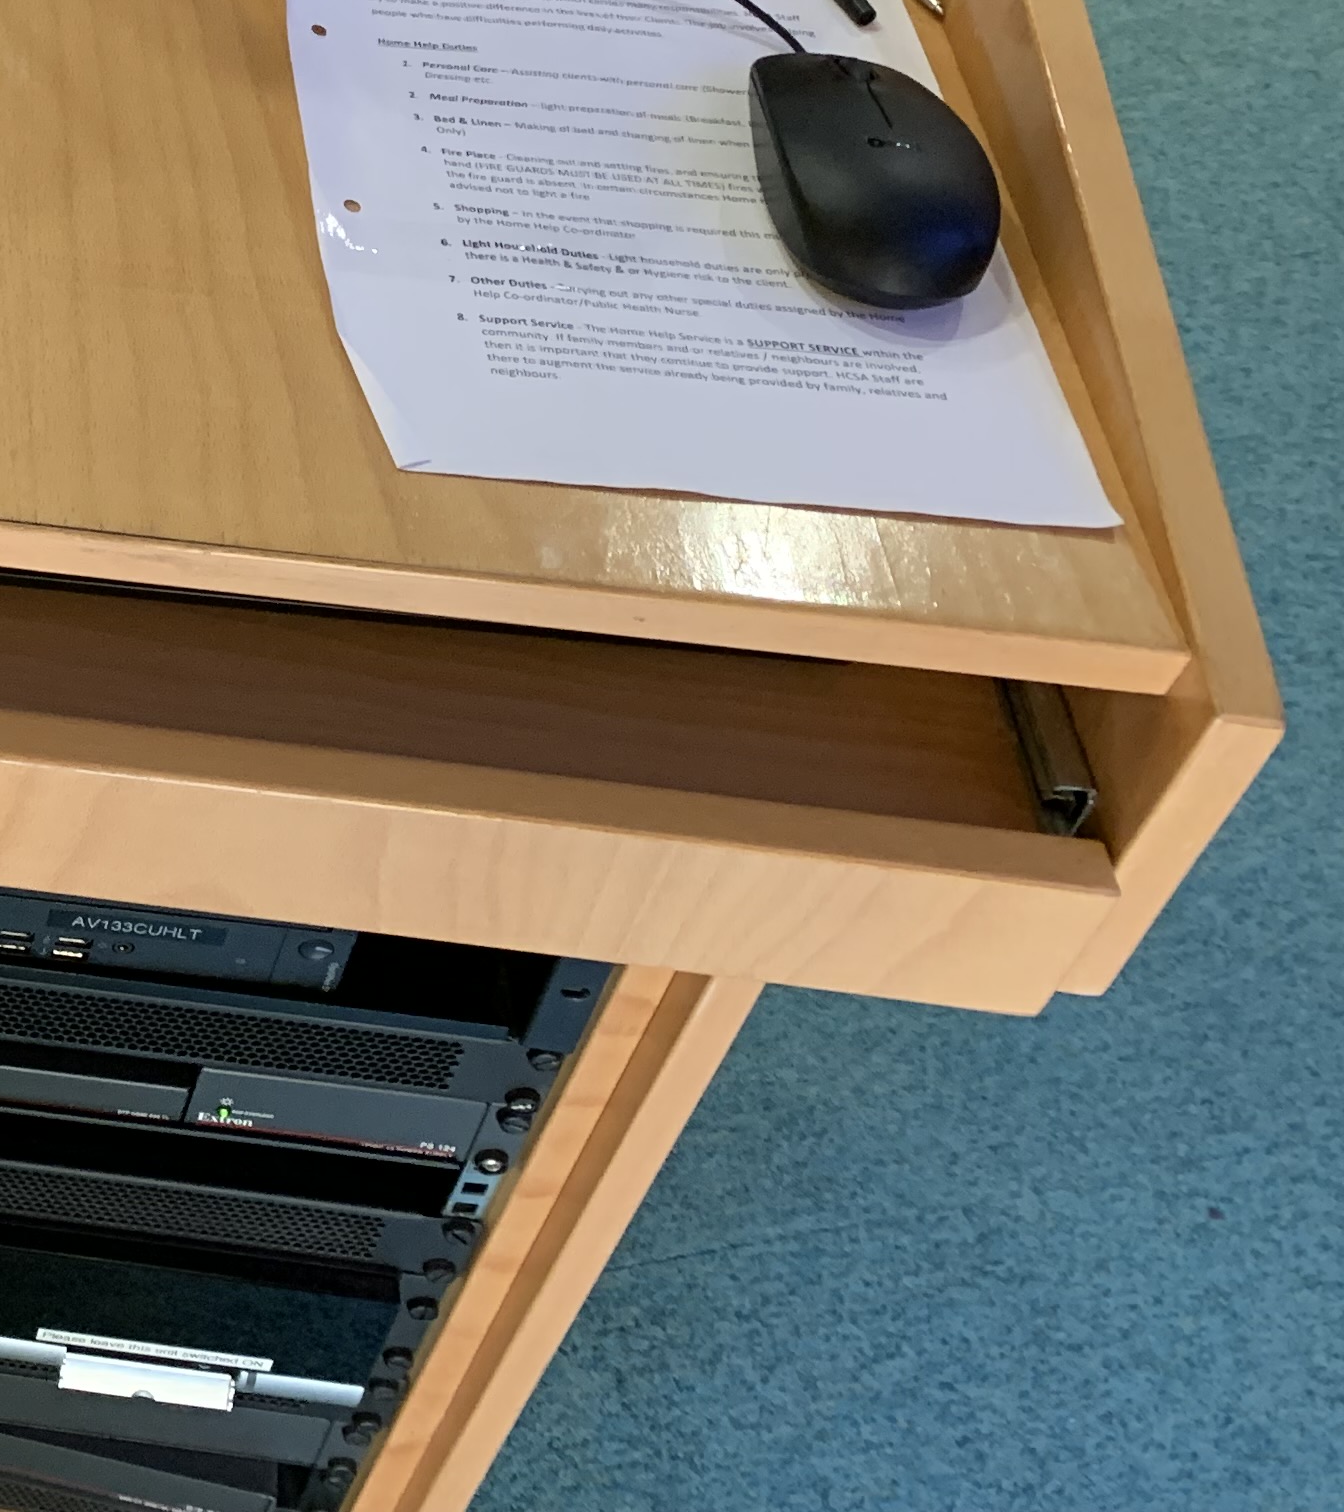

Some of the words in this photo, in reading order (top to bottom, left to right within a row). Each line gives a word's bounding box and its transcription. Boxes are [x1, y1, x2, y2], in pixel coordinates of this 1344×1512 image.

[378, 38, 411, 48] Home
[413, 40, 439, 50] Help
[422, 61, 470, 72] Personal
[429, 93, 458, 102] Meal
[461, 95, 528, 108] Preparation
[433, 115, 456, 124] Bed
[459, 117, 468, 125] &
[471, 118, 501, 127] Linen
[441, 147, 463, 157] Fire
[466, 150, 496, 160] Place
[454, 203, 510, 217] Shopping
[462, 239, 491, 250] Light
[561, 248, 599, 260] Duties
[470, 276, 505, 286] Other
[509, 278, 548, 290] Duties
[474, 289, 501, 300] Help
[622, 302, 662, 314] Health
[479, 313, 528, 327] Support
[531, 318, 574, 330] Service
[584, 323, 606, 334] The
[610, 327, 646, 337] Home
[648, 330, 676, 340] Help
[678, 332, 721, 345] Service
[746, 338, 805, 351] SUPPORT
[809, 343, 858, 356] SERVICE
[862, 349, 900, 359] within
[902, 352, 924, 361] the
[567, 334, 604, 346] family
[607, 338, 662, 352] members
[666, 344, 689, 354] and
[708, 347, 760, 360] relatives
[771, 353, 840, 367] neighbours
[843, 360, 862, 369] are
[484, 340, 512, 350] then
[539, 345, 599, 357] important
[603, 351, 627, 360] that
[630, 353, 658, 365] they
[660, 357, 713, 369] continue
[732, 364, 779, 375] provide
[836, 371, 869, 382] HCSA
[871, 374, 901, 385] Staff
[904, 377, 925, 386] are
[486, 353, 520, 364] there
[539, 358, 593, 371] augment
[595, 362, 617, 372] the
[619, 366, 661, 377] service
[664, 370, 709, 383] already
[711, 374, 746, 386] being
[749, 378, 803, 391] provided
[868, 387, 922, 400] relatives
[924, 391, 948, 401] and
[71, 916, 203, 941] AV133CUHLT
[198, 1111, 253, 1128] Extron
[42, 1331, 86, 1344] Please
[90, 1338, 125, 1350] leave
[128, 1344, 151, 1353] this
[182, 1351, 240, 1365] switched
[241, 1359, 264, 1368] ON
